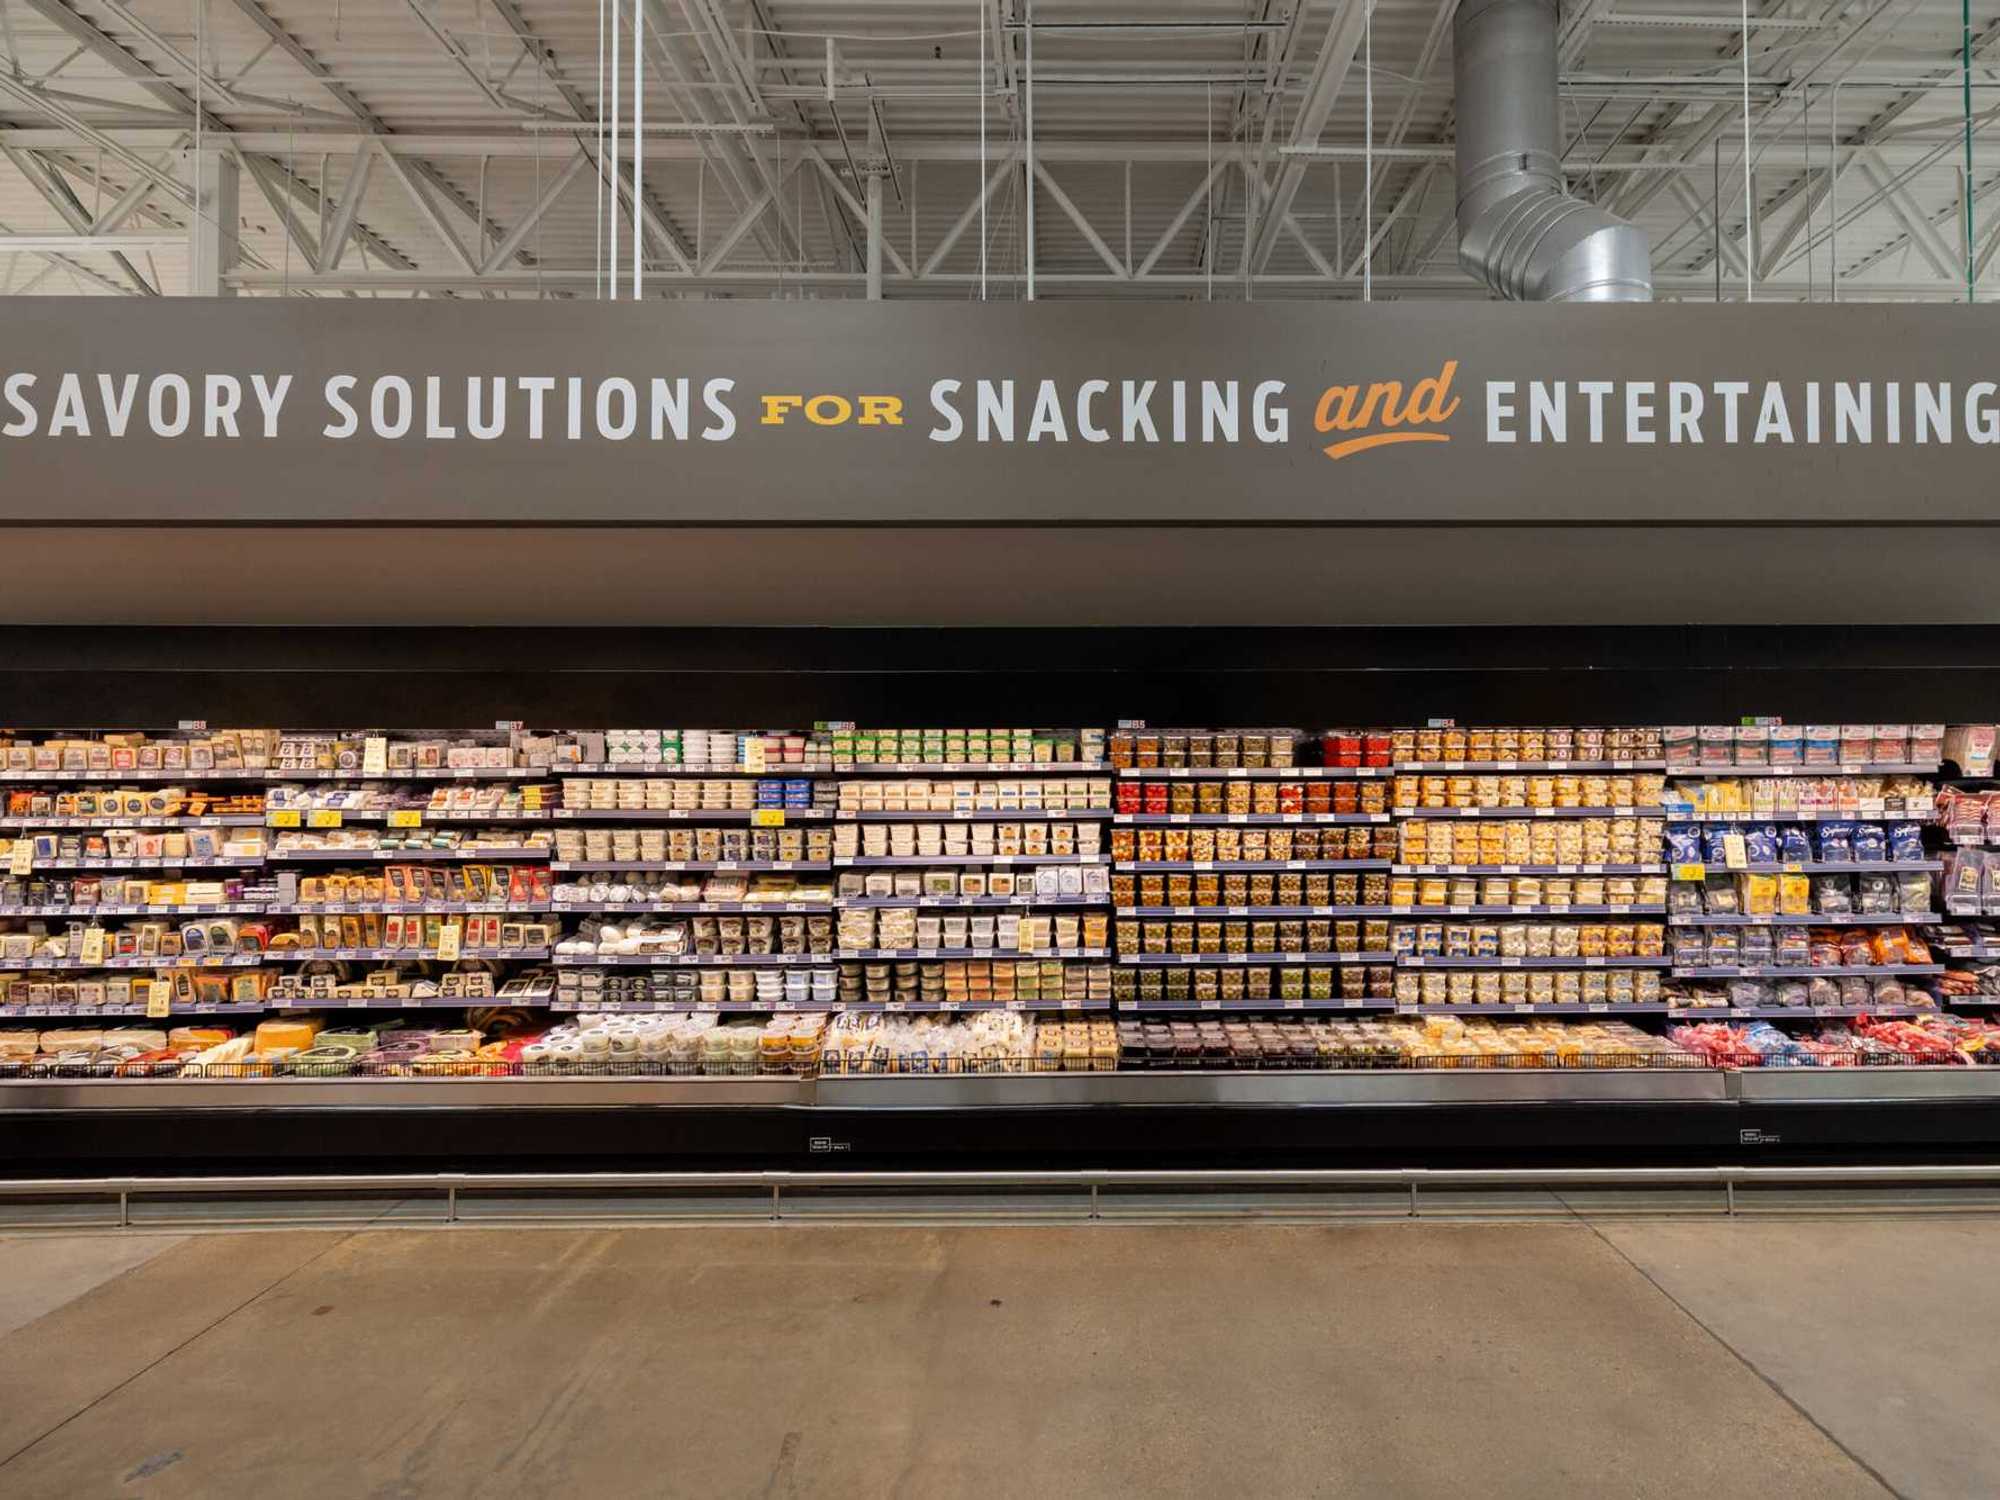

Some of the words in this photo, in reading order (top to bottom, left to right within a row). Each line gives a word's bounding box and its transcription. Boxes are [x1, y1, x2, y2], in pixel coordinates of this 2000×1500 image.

[2, 373, 292, 438] SAVORY
[322, 374, 737, 441] SOLUTIONS
[761, 395, 903, 425] FOR
[928, 379, 1289, 443] SNACKING
[1314, 360, 1462, 434] and
[1486, 380, 2000, 444] ENTERTAINING
